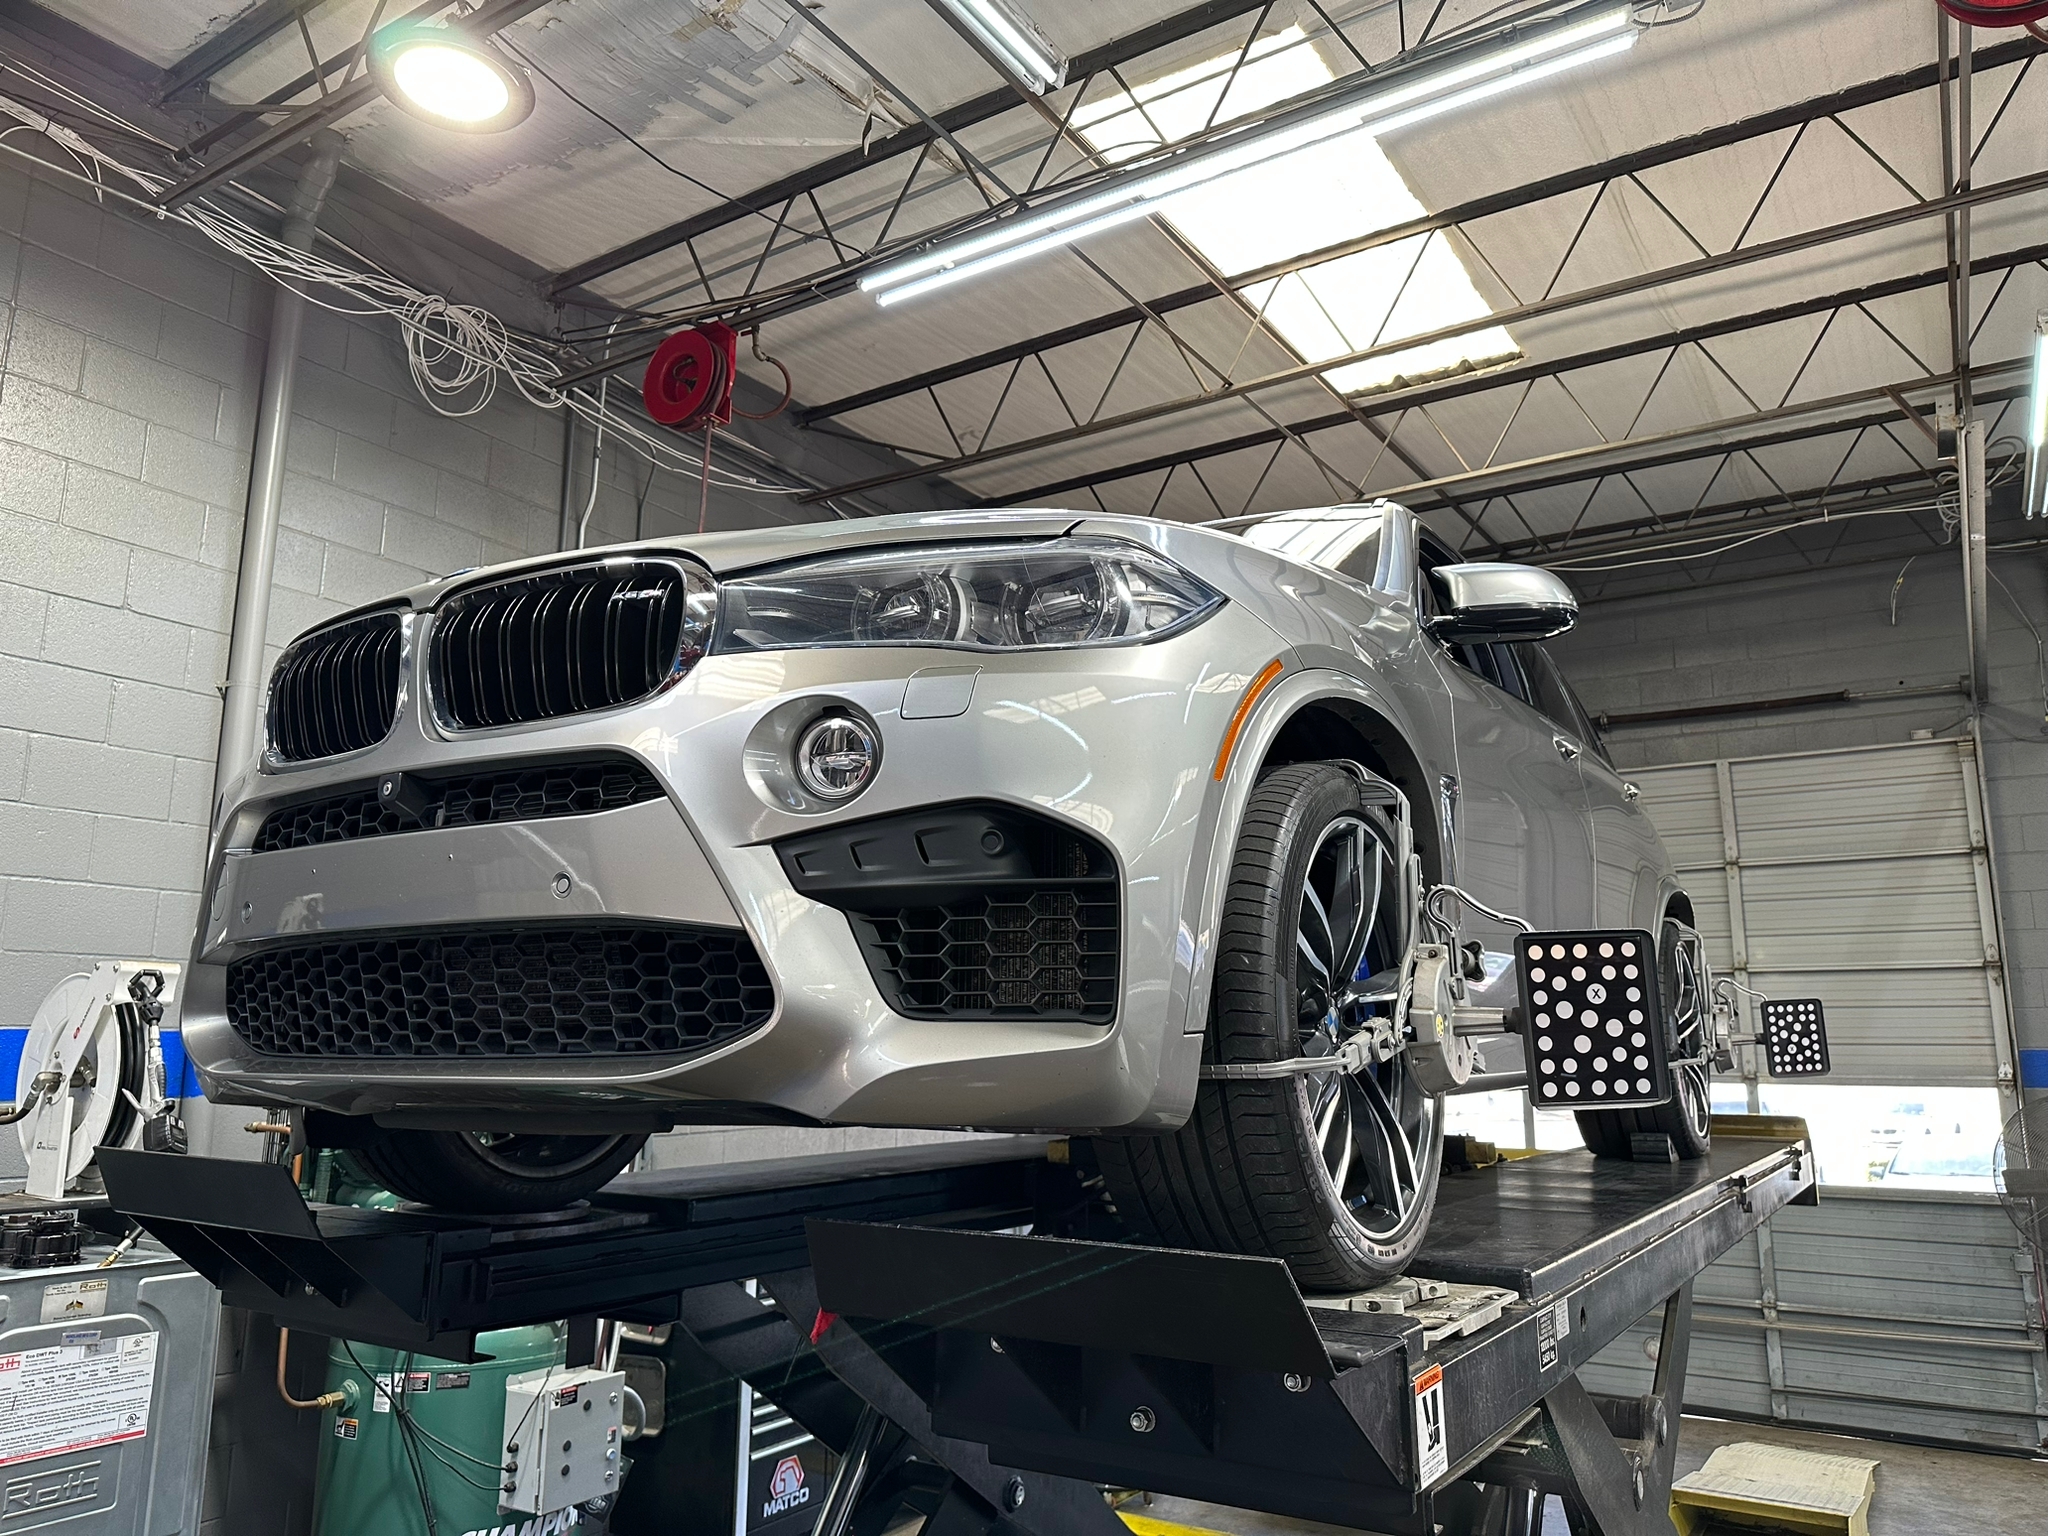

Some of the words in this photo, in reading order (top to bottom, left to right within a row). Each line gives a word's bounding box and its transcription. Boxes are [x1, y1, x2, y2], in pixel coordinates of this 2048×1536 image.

[1591, 988, 1602, 1000] X
[79, 1282, 107, 1290] Roth
[3, 1471, 99, 1512] Roth
[763, 1486, 810, 1518] MATCO
[462, 1505, 579, 1536] MPION
